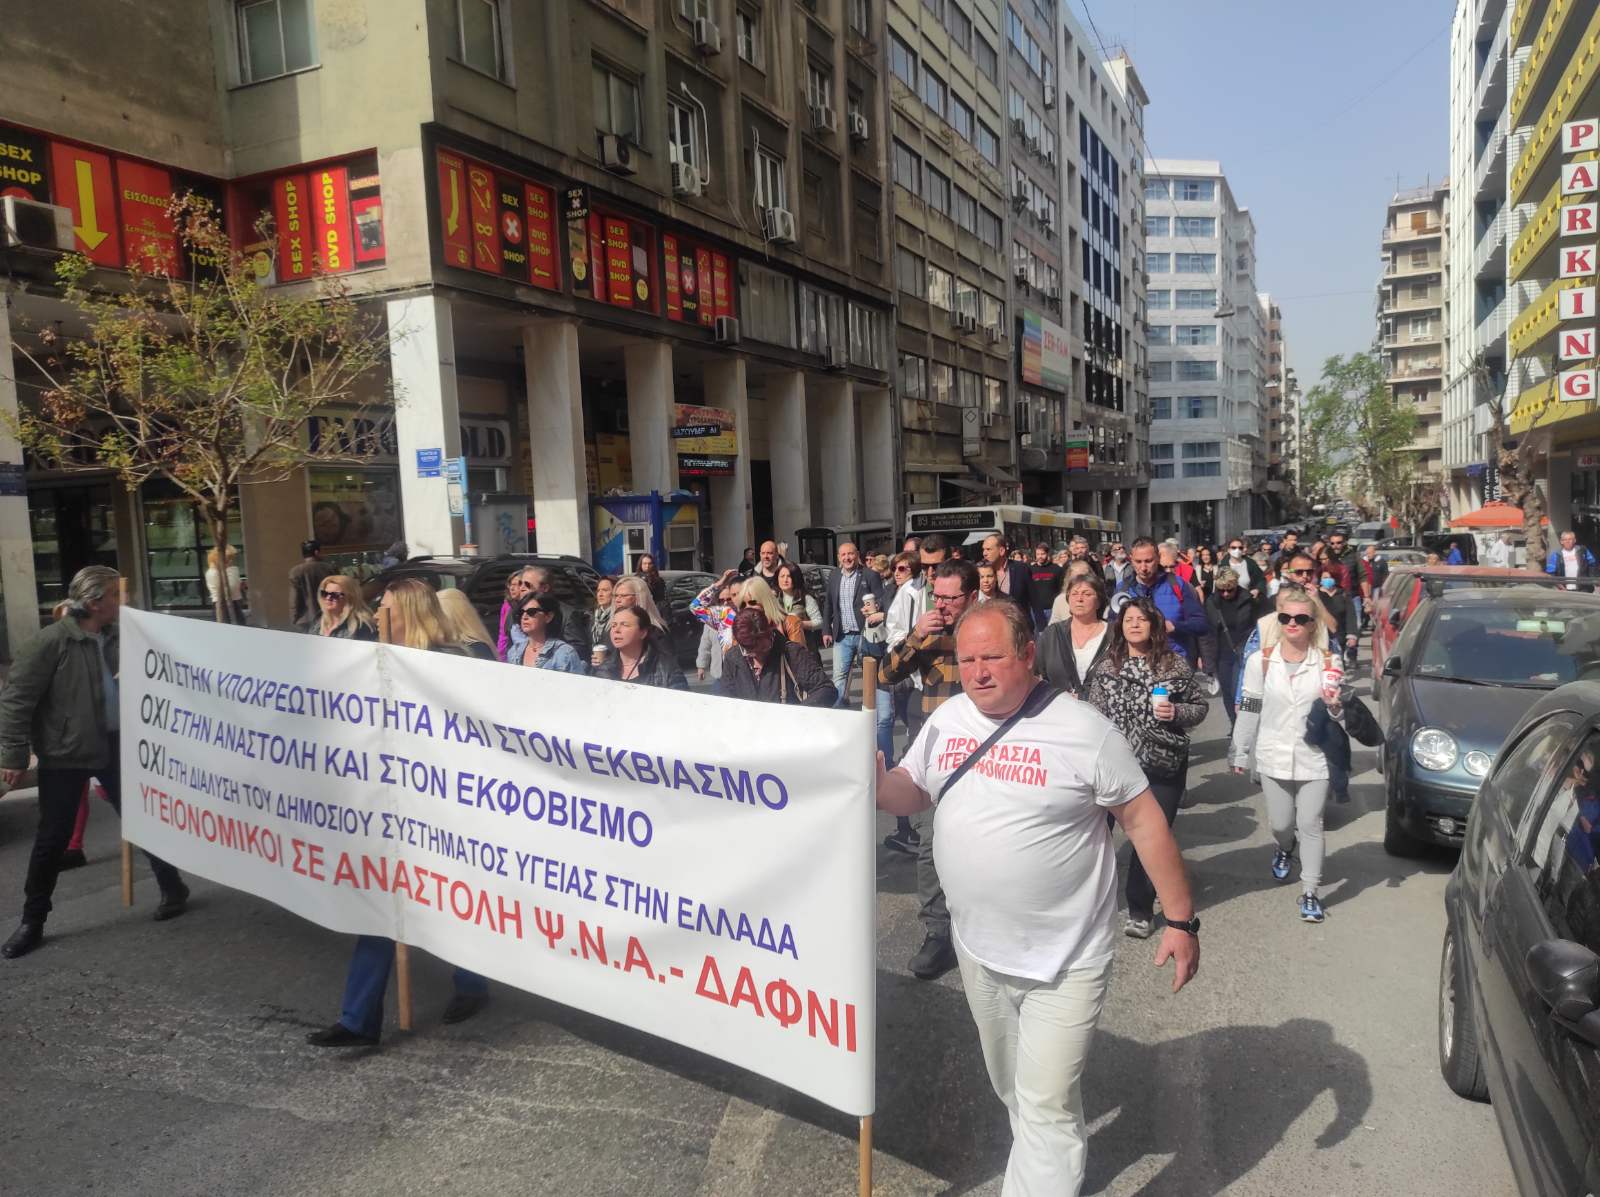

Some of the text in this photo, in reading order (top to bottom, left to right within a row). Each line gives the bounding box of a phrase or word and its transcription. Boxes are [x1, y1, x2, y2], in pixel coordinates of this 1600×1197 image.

[0, 143, 32, 162] SEX
[0, 166, 42, 184] HOP
[502, 193, 519, 208] SEX
[529, 192, 545, 205] SEX
[568, 188, 584, 199] SEX
[321, 171, 340, 268] DVD SHOP
[528, 206, 549, 220] SHOP
[566, 208, 588, 218] SHOP
[286, 180, 303, 273] SEX SHOP
[609, 225, 625, 236] SEX
[530, 243, 551, 257] SHOP
[607, 238, 629, 250] SHOP
[503, 249, 526, 264] SHOP
[611, 258, 627, 269] DVD
[1564, 124, 1594, 396] PARKING
[609, 271, 630, 282] SHOP
[144, 648, 789, 811] ΟΧΙ ΣΤΗΝ ΥΠΟΧΡΕΩΤΙΚΟΤΗΤΑ ΚΑΙ ΣΤΟΝ ΕΚΒΙΑΣΜΟ
[945, 737, 1042, 765] ΠΡΟΤΑΣΙΑ
[140, 693, 654, 848] ΟΧΙ ΣΤΗΝ ΑΝΑΣΤΟΛΗ ΚΑΙ ΣΤΟΝ ΕΚΦΟΒΙΣΜΟ
[138, 738, 799, 961] ΟΧΙ ΣΤΗ ΔΙΑΛΥΣΗ ΤΟΥ ΔΗΜΟΣΙΟΥ ΣΥΣΤΗΜΑΤΟΣ ΥΓΕΙΑΣ ΣΤΗΝ ΕΛΛΑΔΑ
[140, 782, 285, 868] ΥΓΕΙΟΝΟΜΙΚΟΙ
[292, 837, 326, 882] ΣΕ
[334, 851, 523, 940] ΑΝΑΣΤΟΛΗ
[695, 955, 857, 1053] ΔΑΦΝΙ
